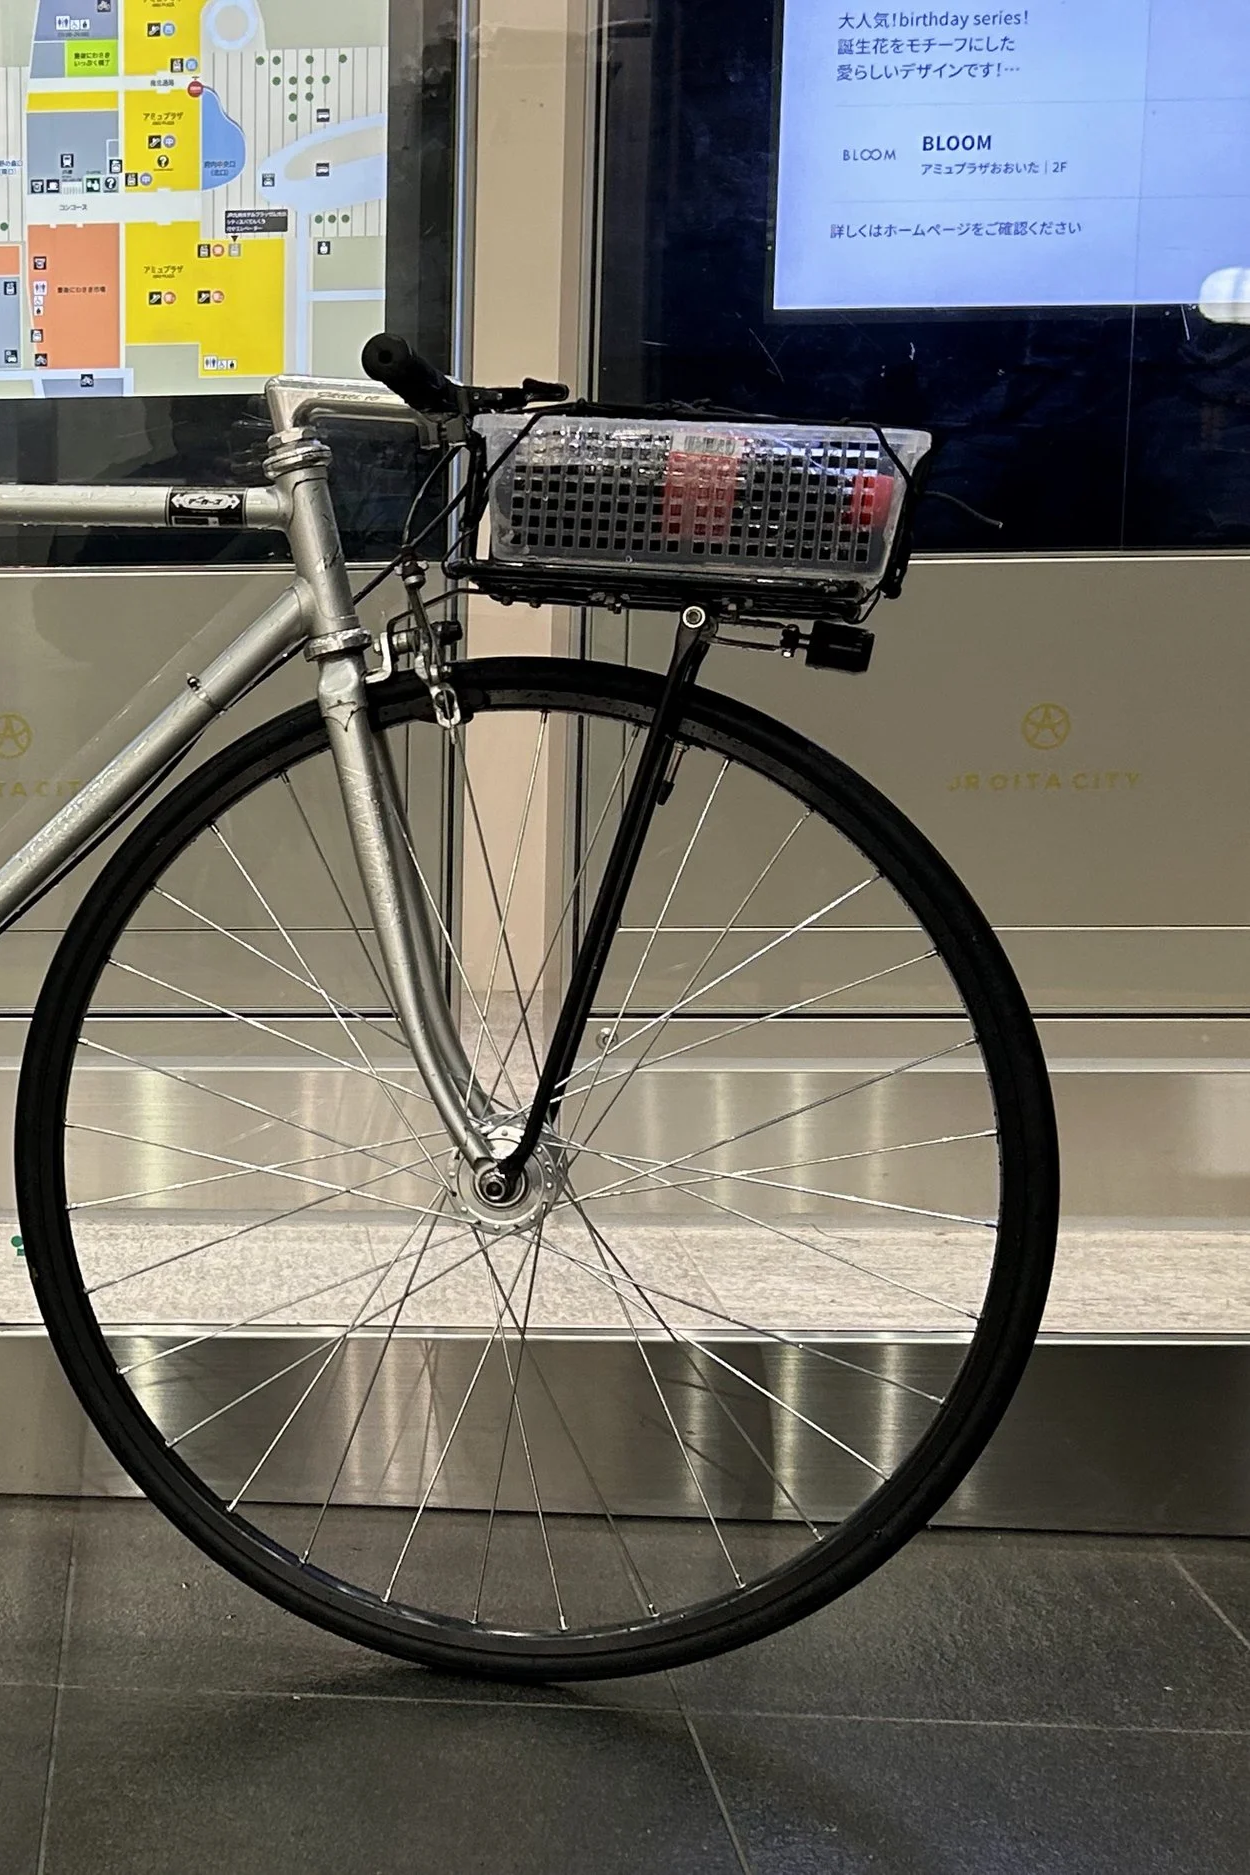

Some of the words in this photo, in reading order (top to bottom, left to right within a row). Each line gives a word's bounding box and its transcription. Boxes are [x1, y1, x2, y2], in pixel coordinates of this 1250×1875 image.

[973, 10, 1029, 25] series!
[837, 36, 1015, 55] 誕生花をモチーフにした
[143, 112, 183, 121] アミュプラザ
[922, 134, 992, 152] BLOOM
[842, 148, 896, 161] BLOOM
[1053, 161, 1067, 173] 2F
[830, 221, 1082, 239] 詳しくはホームページをご確認ください
[143, 265, 183, 274] アミュプラザ
[34, 779, 81, 798] CIT
[947, 773, 980, 791] JR
[989, 773, 1062, 790] OITA
[1072, 772, 1141, 790] CITY
